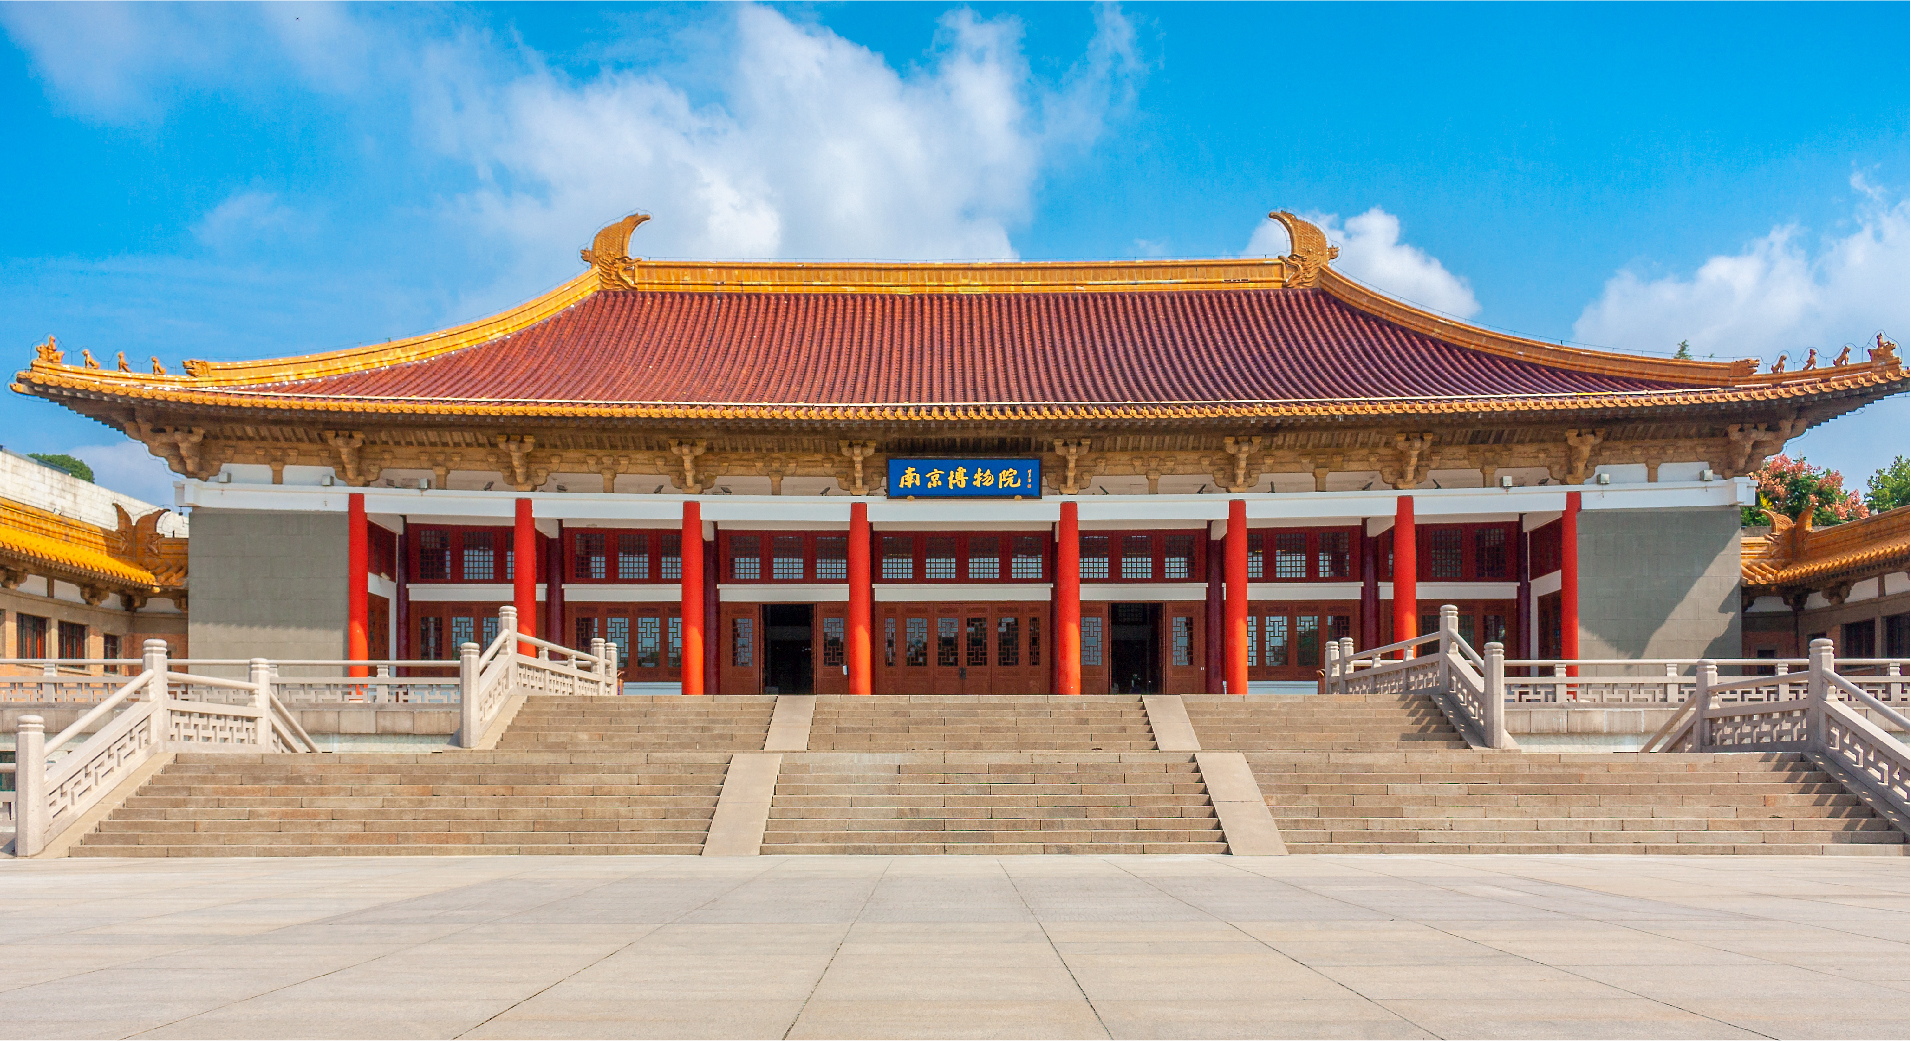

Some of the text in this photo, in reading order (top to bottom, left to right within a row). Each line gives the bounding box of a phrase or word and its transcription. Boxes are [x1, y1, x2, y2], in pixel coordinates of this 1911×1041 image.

[899, 466, 1021, 489] 南京博物院
